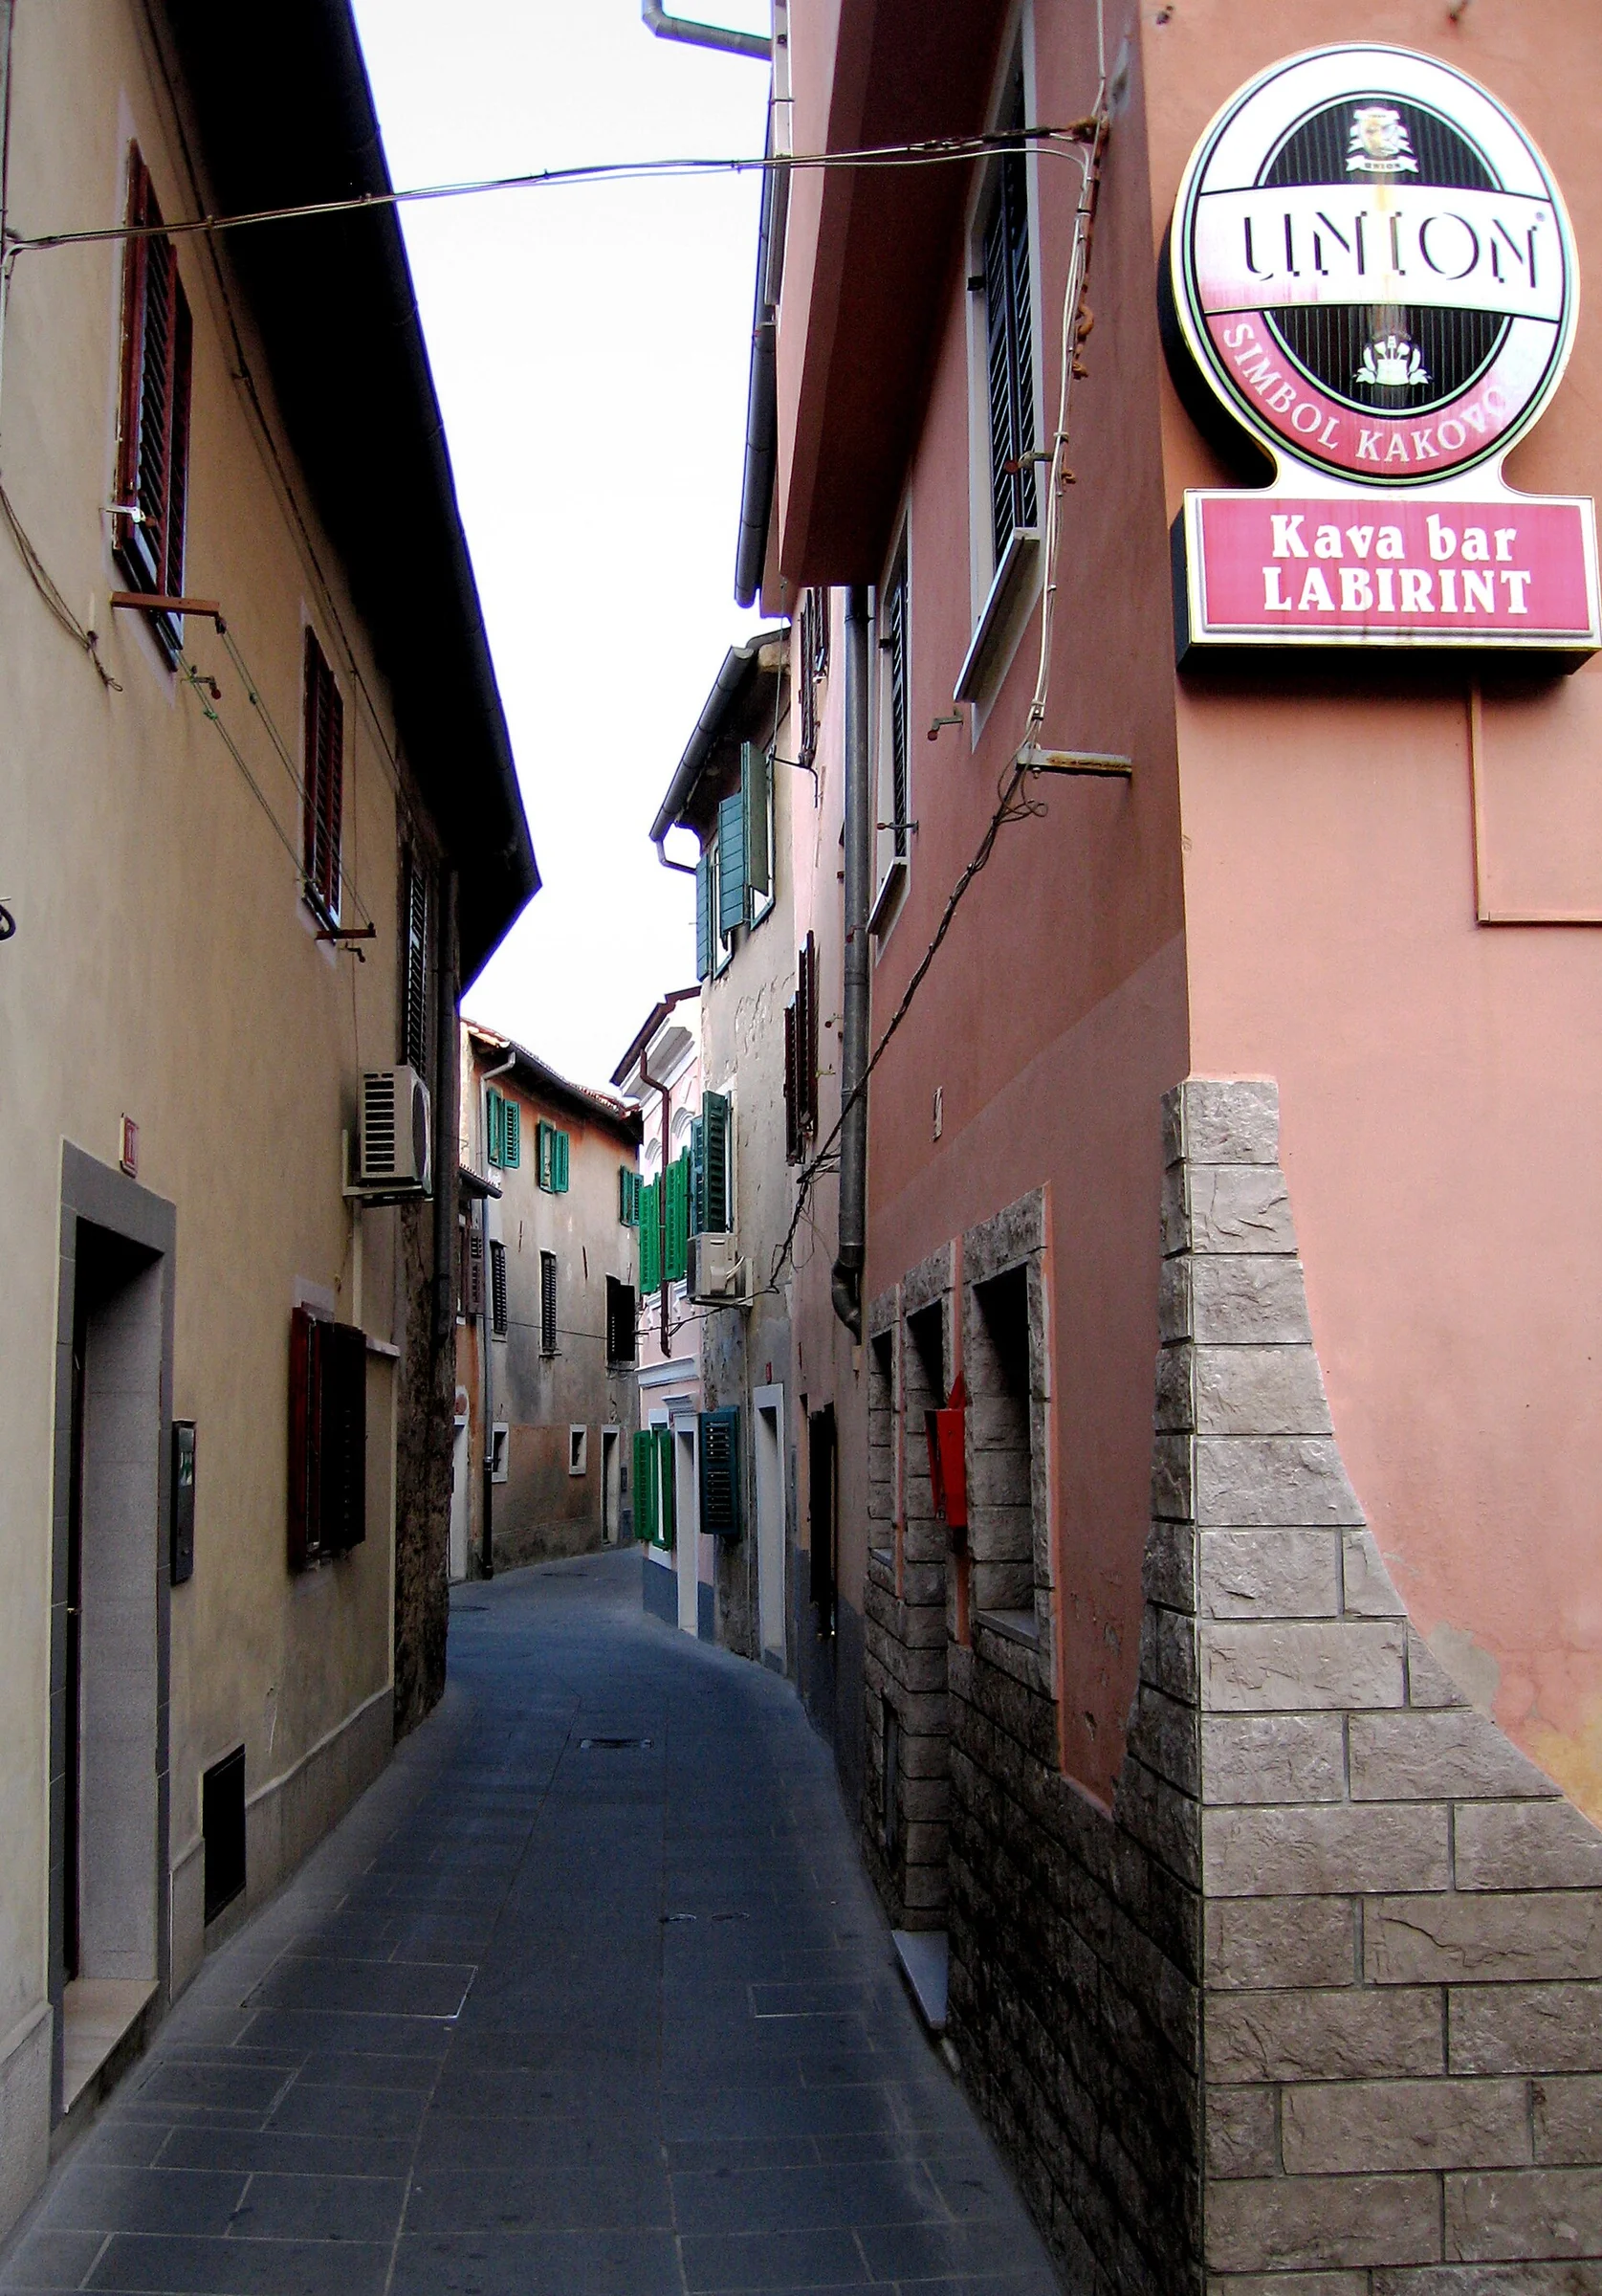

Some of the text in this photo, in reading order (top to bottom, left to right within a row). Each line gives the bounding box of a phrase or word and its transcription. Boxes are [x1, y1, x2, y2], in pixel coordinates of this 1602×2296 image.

[1243, 210, 1537, 289] UNION
[1223, 322, 1339, 450] SIMBOL
[1270, 513, 1517, 563] Kava bar
[1262, 566, 1531, 615] LABIRINT
